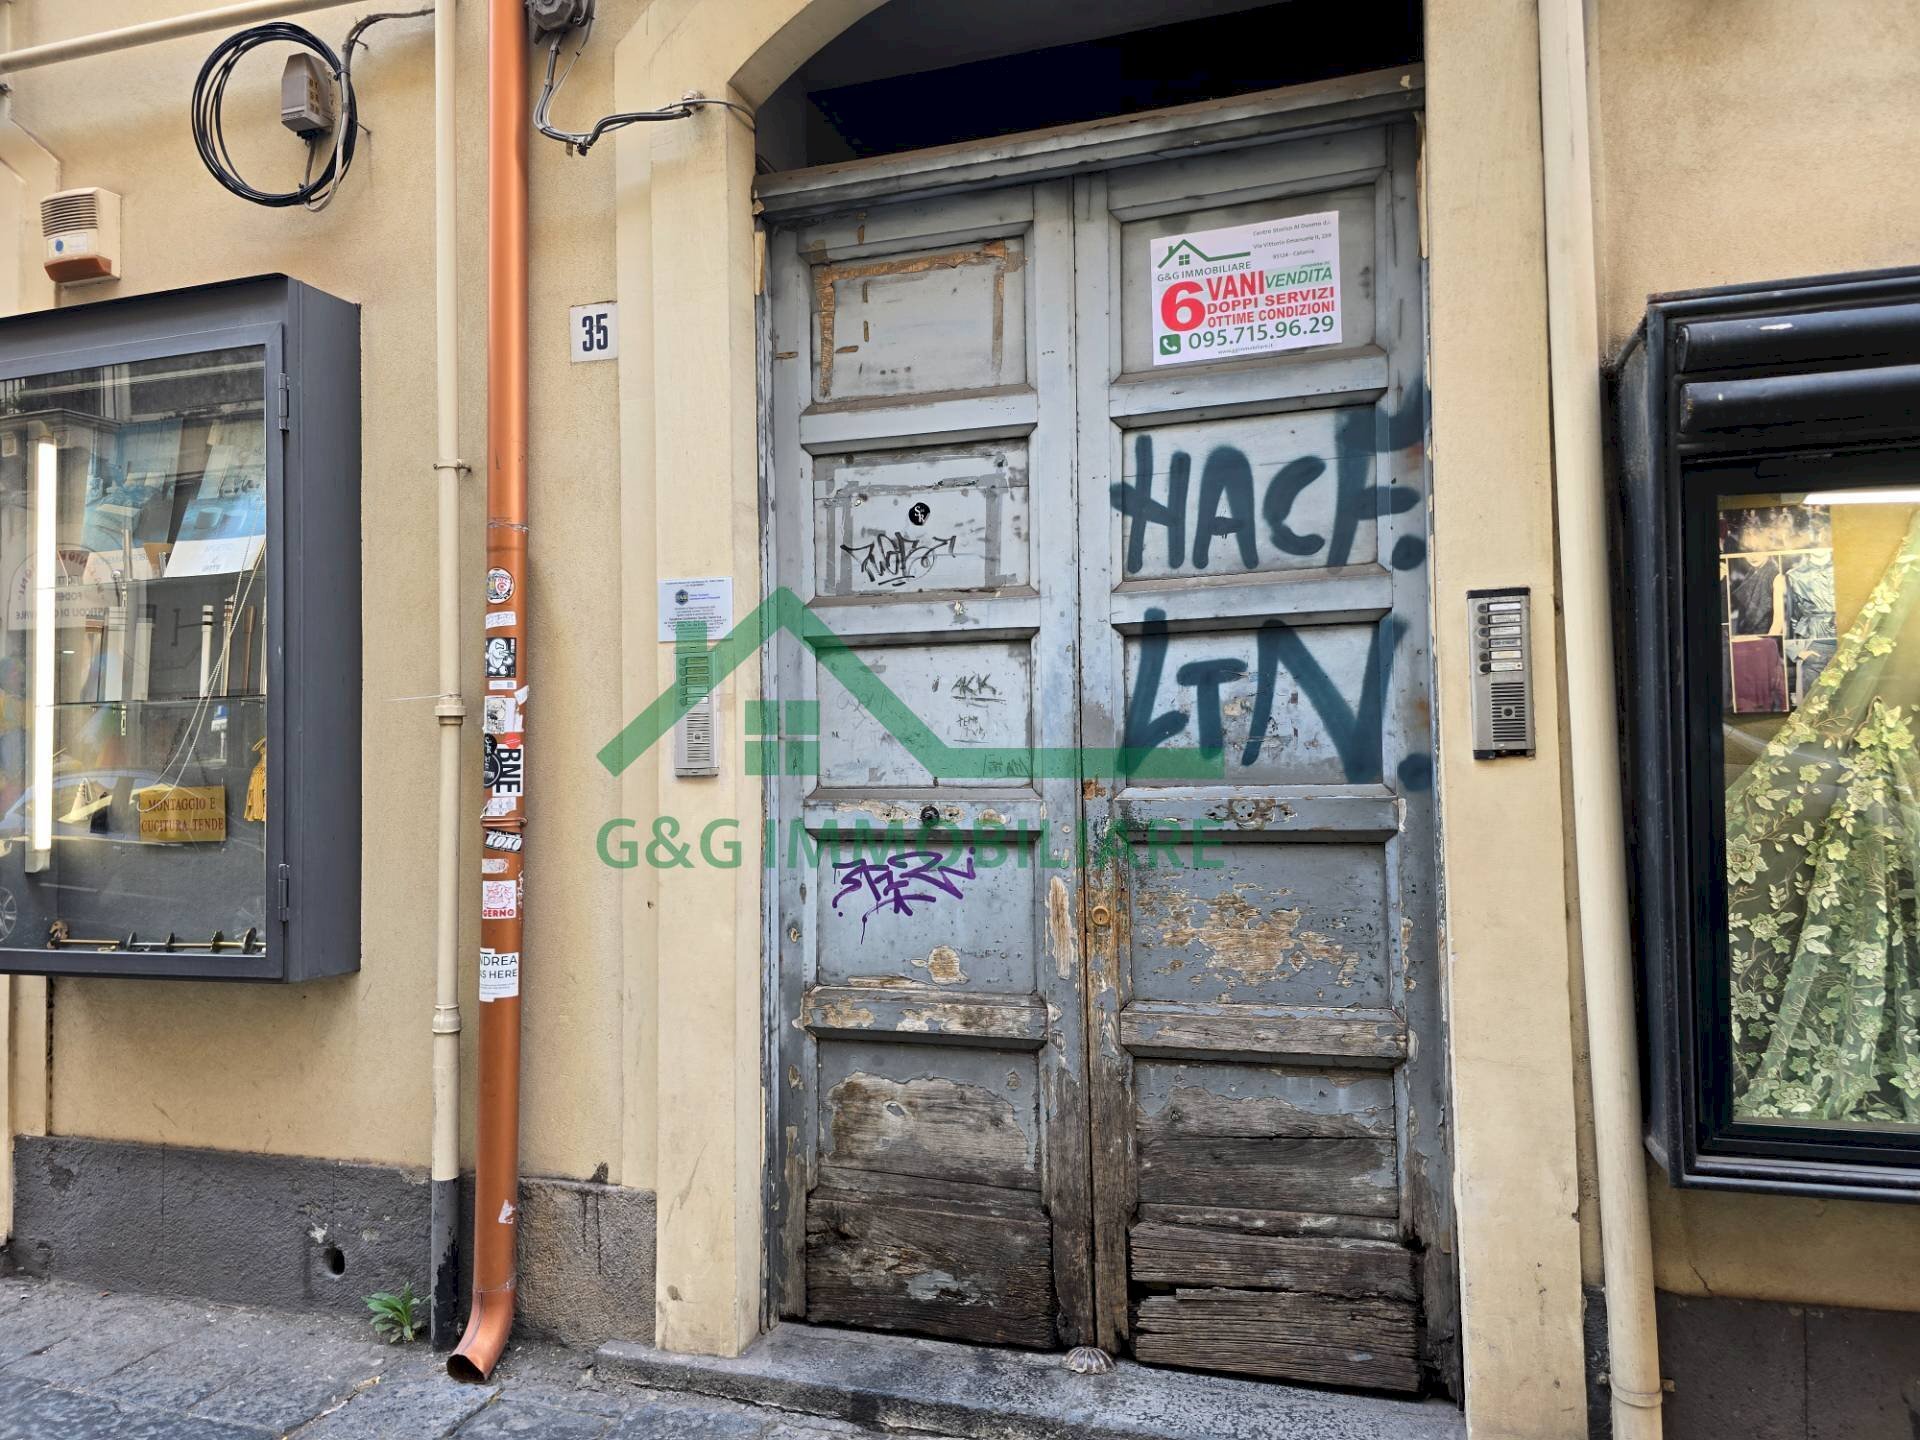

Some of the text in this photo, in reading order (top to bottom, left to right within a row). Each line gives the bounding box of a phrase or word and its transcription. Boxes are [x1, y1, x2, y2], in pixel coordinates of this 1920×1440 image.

[1157, 261, 1252, 282] G&G IMMOBILIARE
[1206, 270, 1265, 300] VANI
[1265, 266, 1333, 289] VENDITA
[1160, 280, 1206, 332] 6
[1207, 286, 1335, 314] DOPPI SERVIZI
[1208, 300, 1335, 328] OTTIME CONDIZIONI
[582, 312, 608, 352] 35
[1188, 314, 1334, 349] 095.715.96.29
[149, 797, 216, 812] MONTAGGIO E
[142, 817, 224, 833] CUCITURA TENDE
[489, 969, 517, 979] HERE
